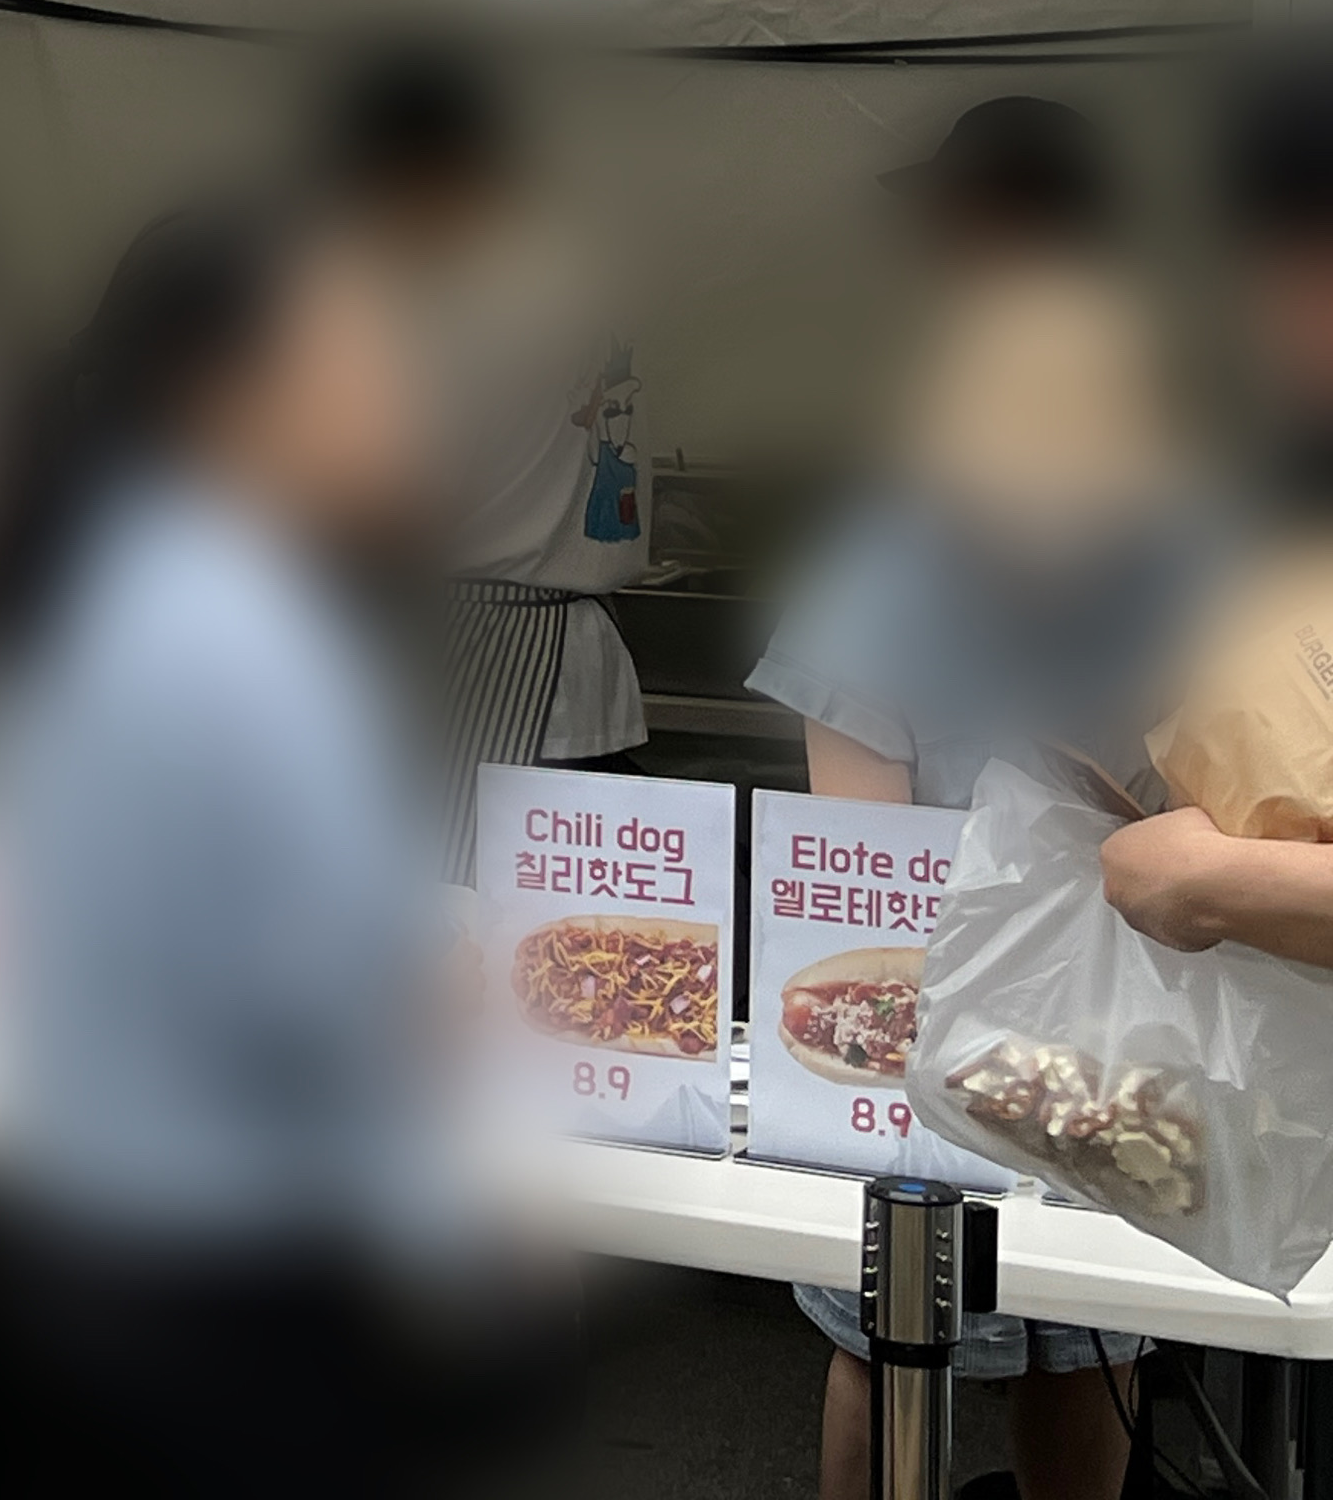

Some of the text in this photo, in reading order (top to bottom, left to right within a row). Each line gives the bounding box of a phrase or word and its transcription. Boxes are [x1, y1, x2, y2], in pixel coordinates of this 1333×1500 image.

[525, 808, 685, 862] Chili dog
[791, 834, 952, 886] Elote do
[513, 851, 695, 906] 칠리핫도그
[572, 1062, 631, 1101] 8.9
[851, 1097, 912, 1138] 8.9
